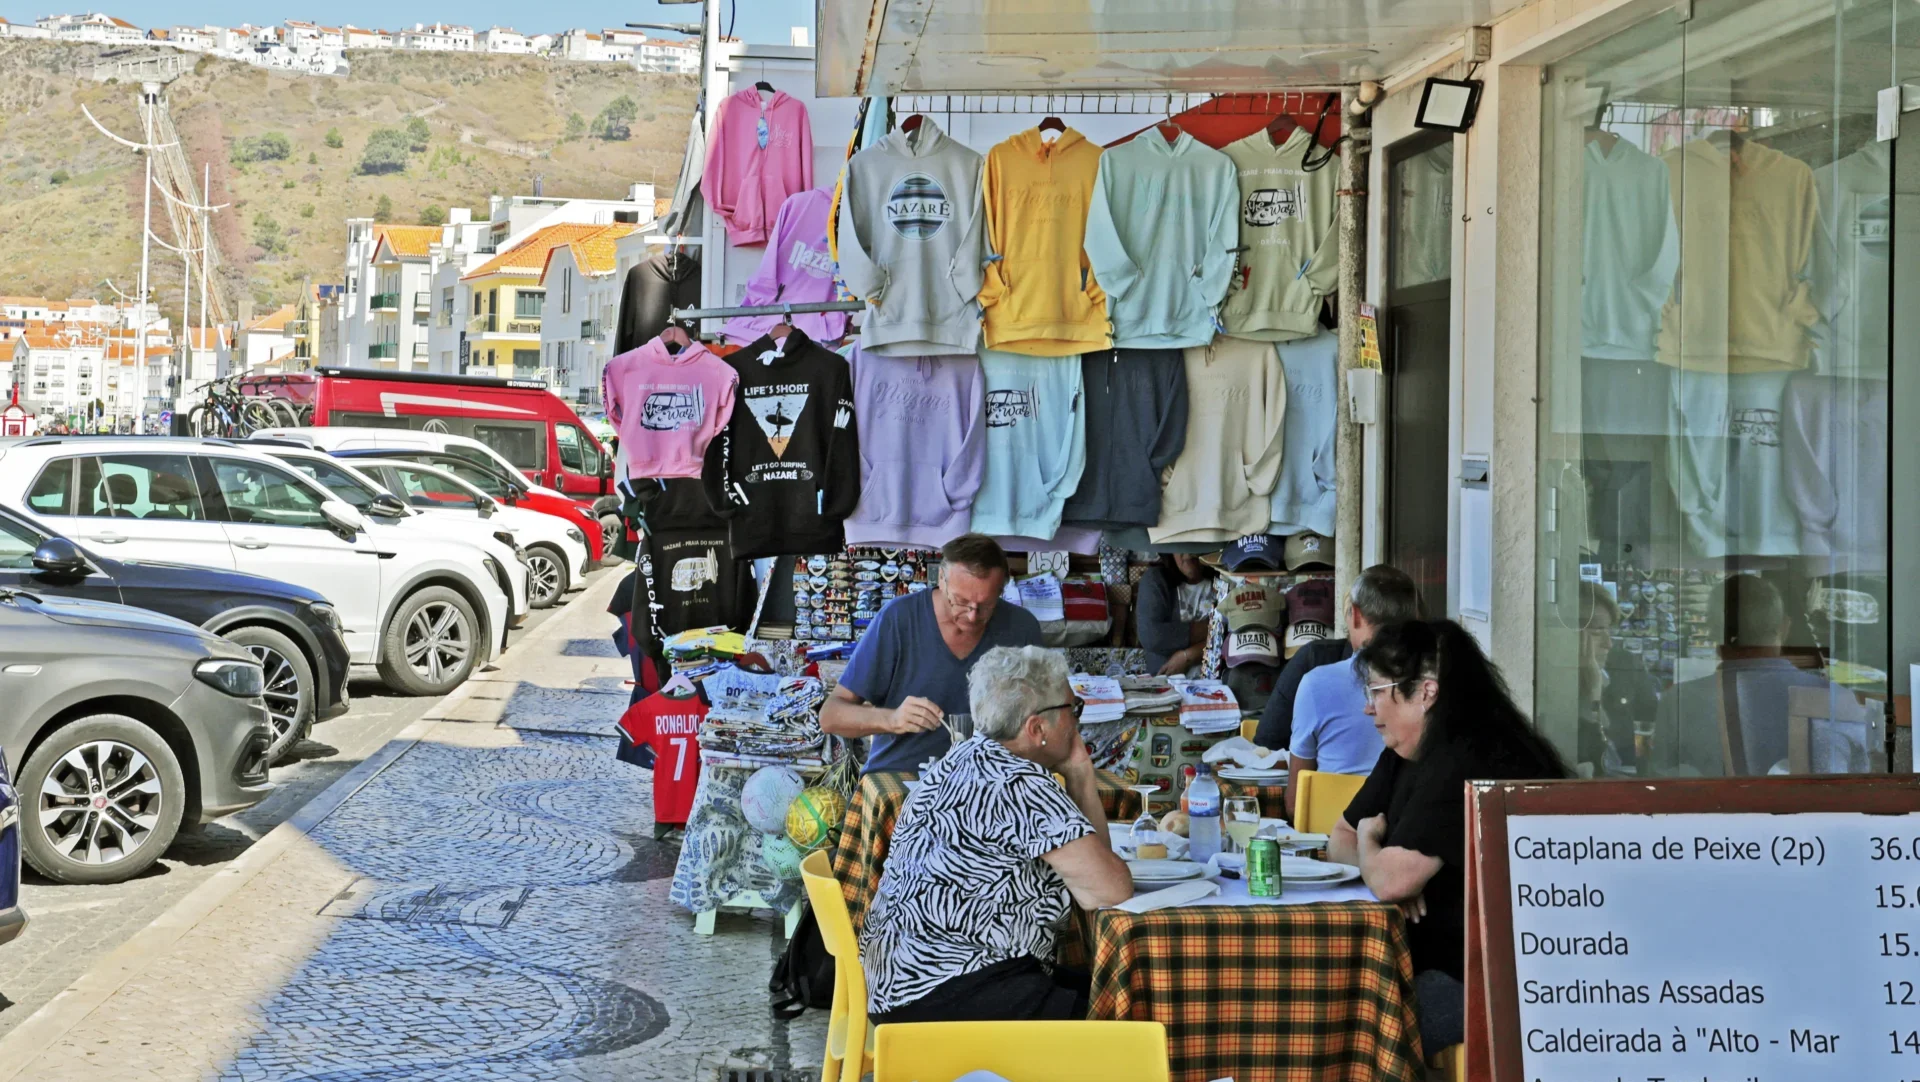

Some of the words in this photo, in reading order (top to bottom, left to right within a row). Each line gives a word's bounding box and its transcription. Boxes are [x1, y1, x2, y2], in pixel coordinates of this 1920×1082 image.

[886, 200, 951, 218] NAZARÉ
[776, 383, 810, 394] SHORT
[763, 469, 798, 481] NAZARÉ
[780, 461, 807, 469] SURFING
[670, 737, 688, 781] 7
[1514, 835, 1642, 866] Cataplana
[1652, 835, 1684, 861] de
[1694, 836, 1761, 861] Peixe
[1771, 835, 1826, 866] (2p)
[1517, 883, 1605, 908] Robalo
[1874, 884, 1920, 909] 15.
[1520, 931, 1629, 956] Dourada
[1523, 979, 1650, 1005] Sardinhas
[1659, 979, 1765, 1005] Assadas
[1883, 981, 1920, 1005] 12
[1526, 1028, 1662, 1053] Caldeirada
[1672, 1026, 1687, 1053] à
[1696, 1028, 1760, 1053] "Alto
[1790, 1029, 1840, 1054] Mar
